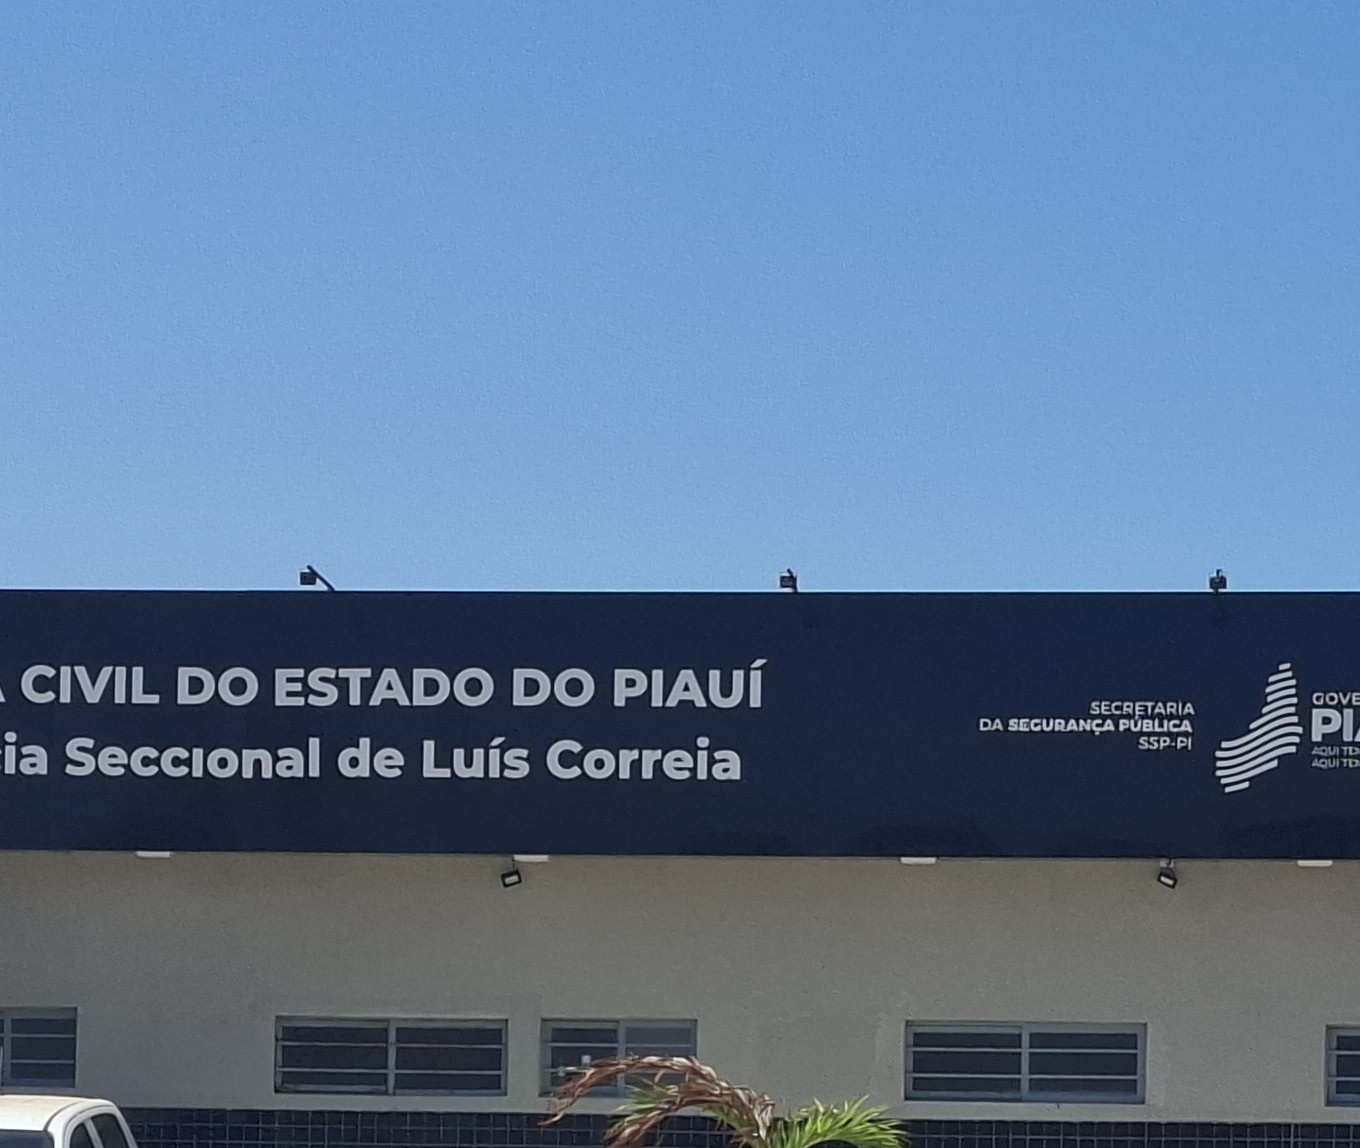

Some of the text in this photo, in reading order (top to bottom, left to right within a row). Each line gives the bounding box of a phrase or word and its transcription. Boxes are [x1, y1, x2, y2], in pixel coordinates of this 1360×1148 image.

[19, 663, 160, 707] CIVIL
[177, 664, 260, 708] DO
[274, 665, 494, 709] ESTADO
[511, 666, 595, 710] DO
[613, 656, 769, 710] PIAUÍ
[1090, 700, 1195, 716] SECRETARIA
[979, 715, 1193, 735] DA SEGURANÇA PÚBLICA
[1138, 736, 1192, 750] SSP-PI
[337, 737, 403, 781] de
[422, 736, 529, 781] Luís
[545, 737, 741, 782] Correia
